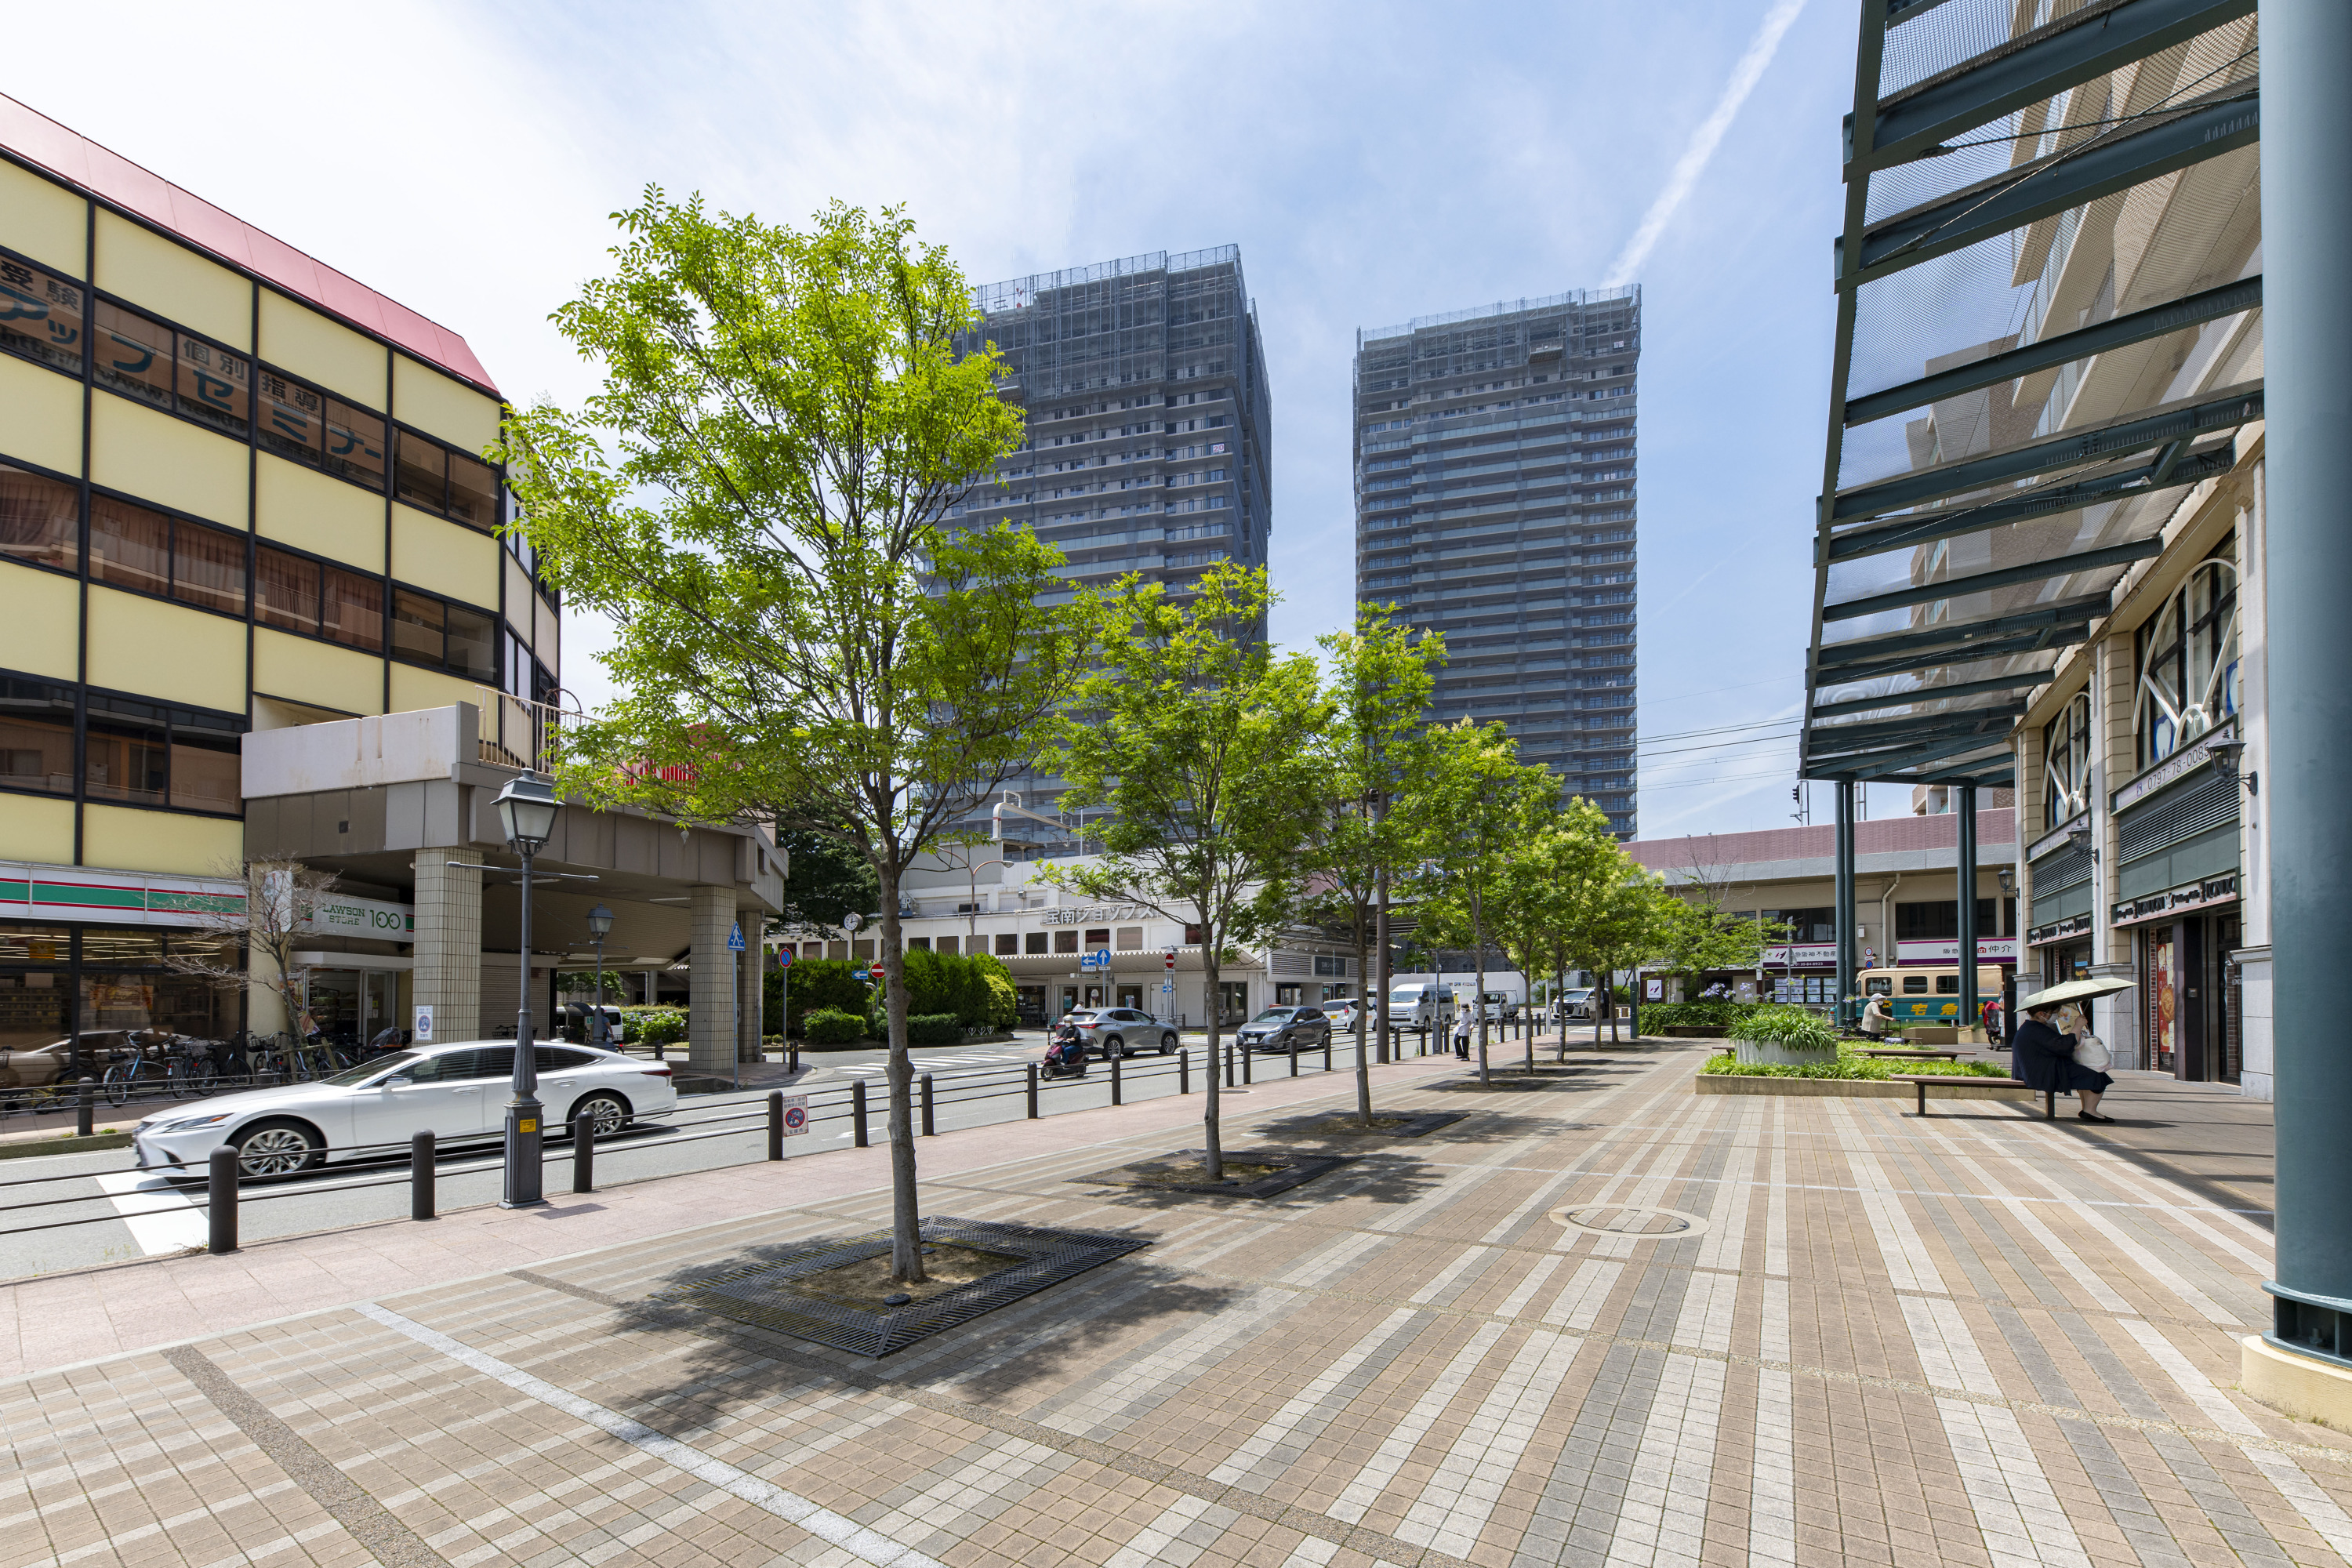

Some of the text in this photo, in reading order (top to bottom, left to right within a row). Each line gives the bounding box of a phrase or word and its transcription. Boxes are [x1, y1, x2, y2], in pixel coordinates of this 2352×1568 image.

[2147, 742, 2209, 789] 0797-78-0085
[323, 904, 365, 917] LAWSON
[370, 909, 401, 930] 100
[329, 915, 360, 926] STORE
